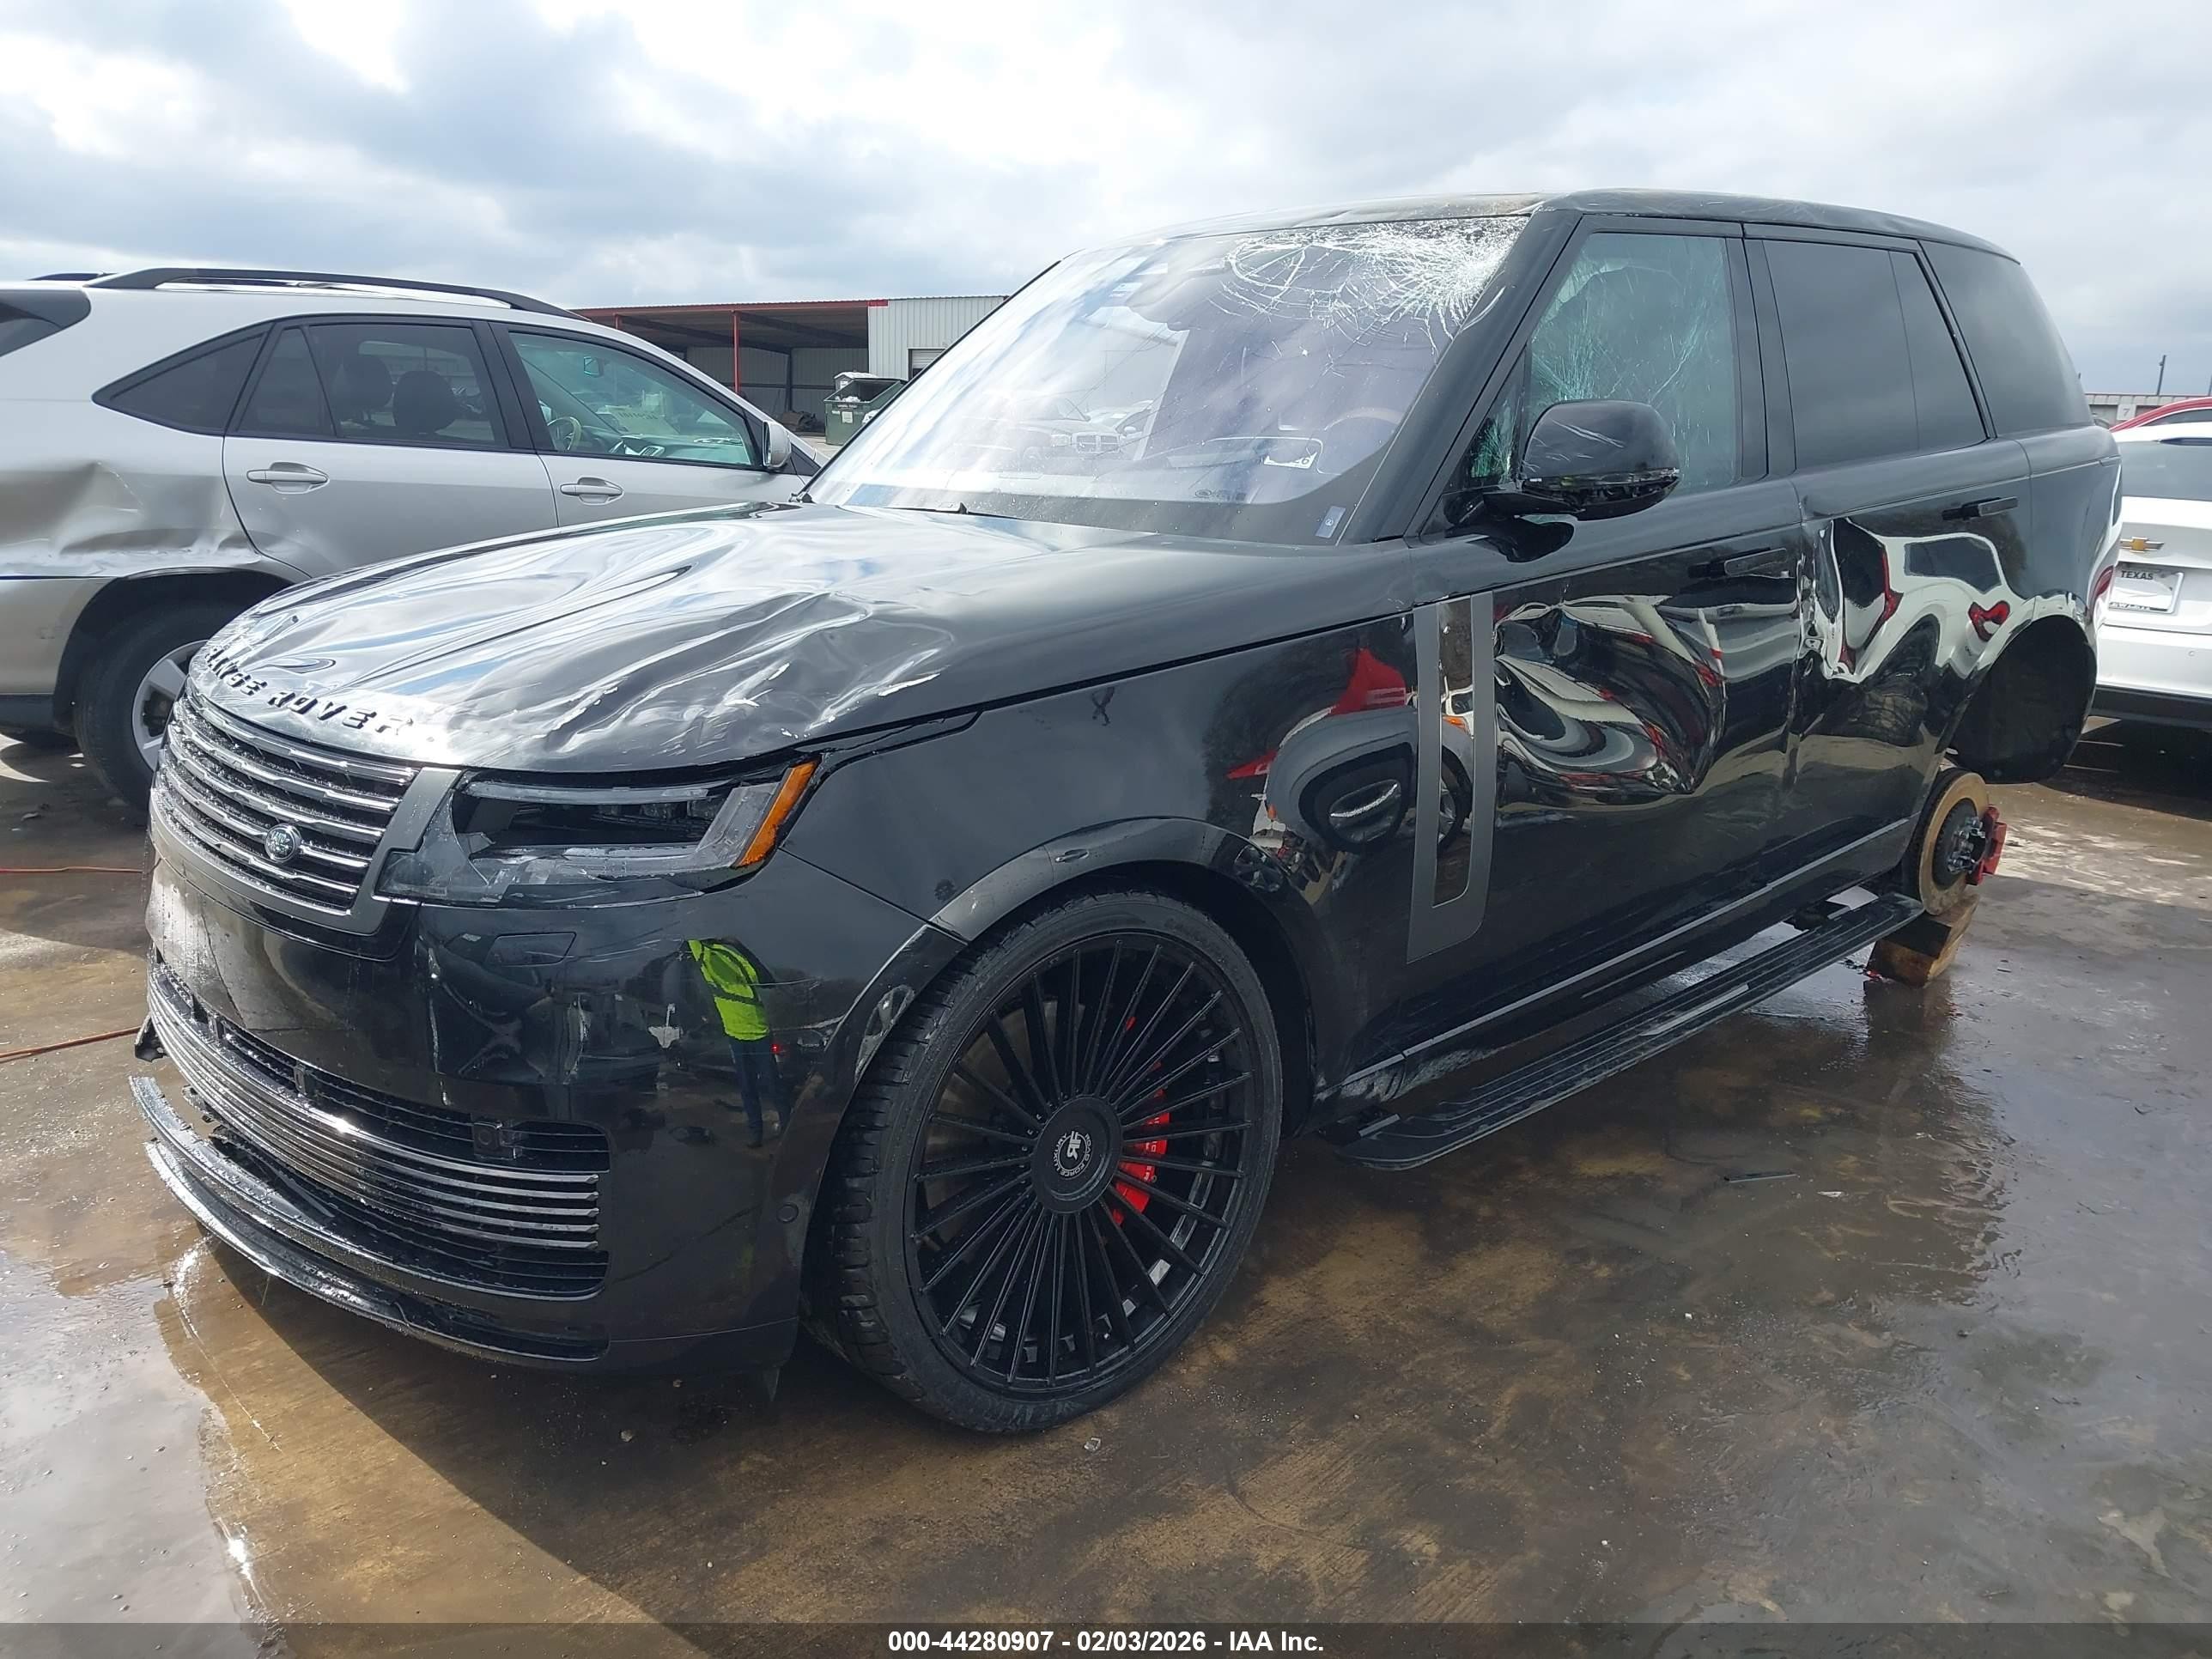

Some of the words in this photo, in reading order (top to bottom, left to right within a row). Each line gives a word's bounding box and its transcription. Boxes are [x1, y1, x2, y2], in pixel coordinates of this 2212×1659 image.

[2123, 408, 2130, 417] 7
[2120, 570, 2154, 580] TEXAS
[204, 647, 268, 696] RANGE
[267, 690, 415, 736] ROVER
[1053, 1133, 1067, 1172] LUXURY
[1084, 1133, 1092, 1162] ROAD
[1060, 1163, 1085, 1177] FORCE
